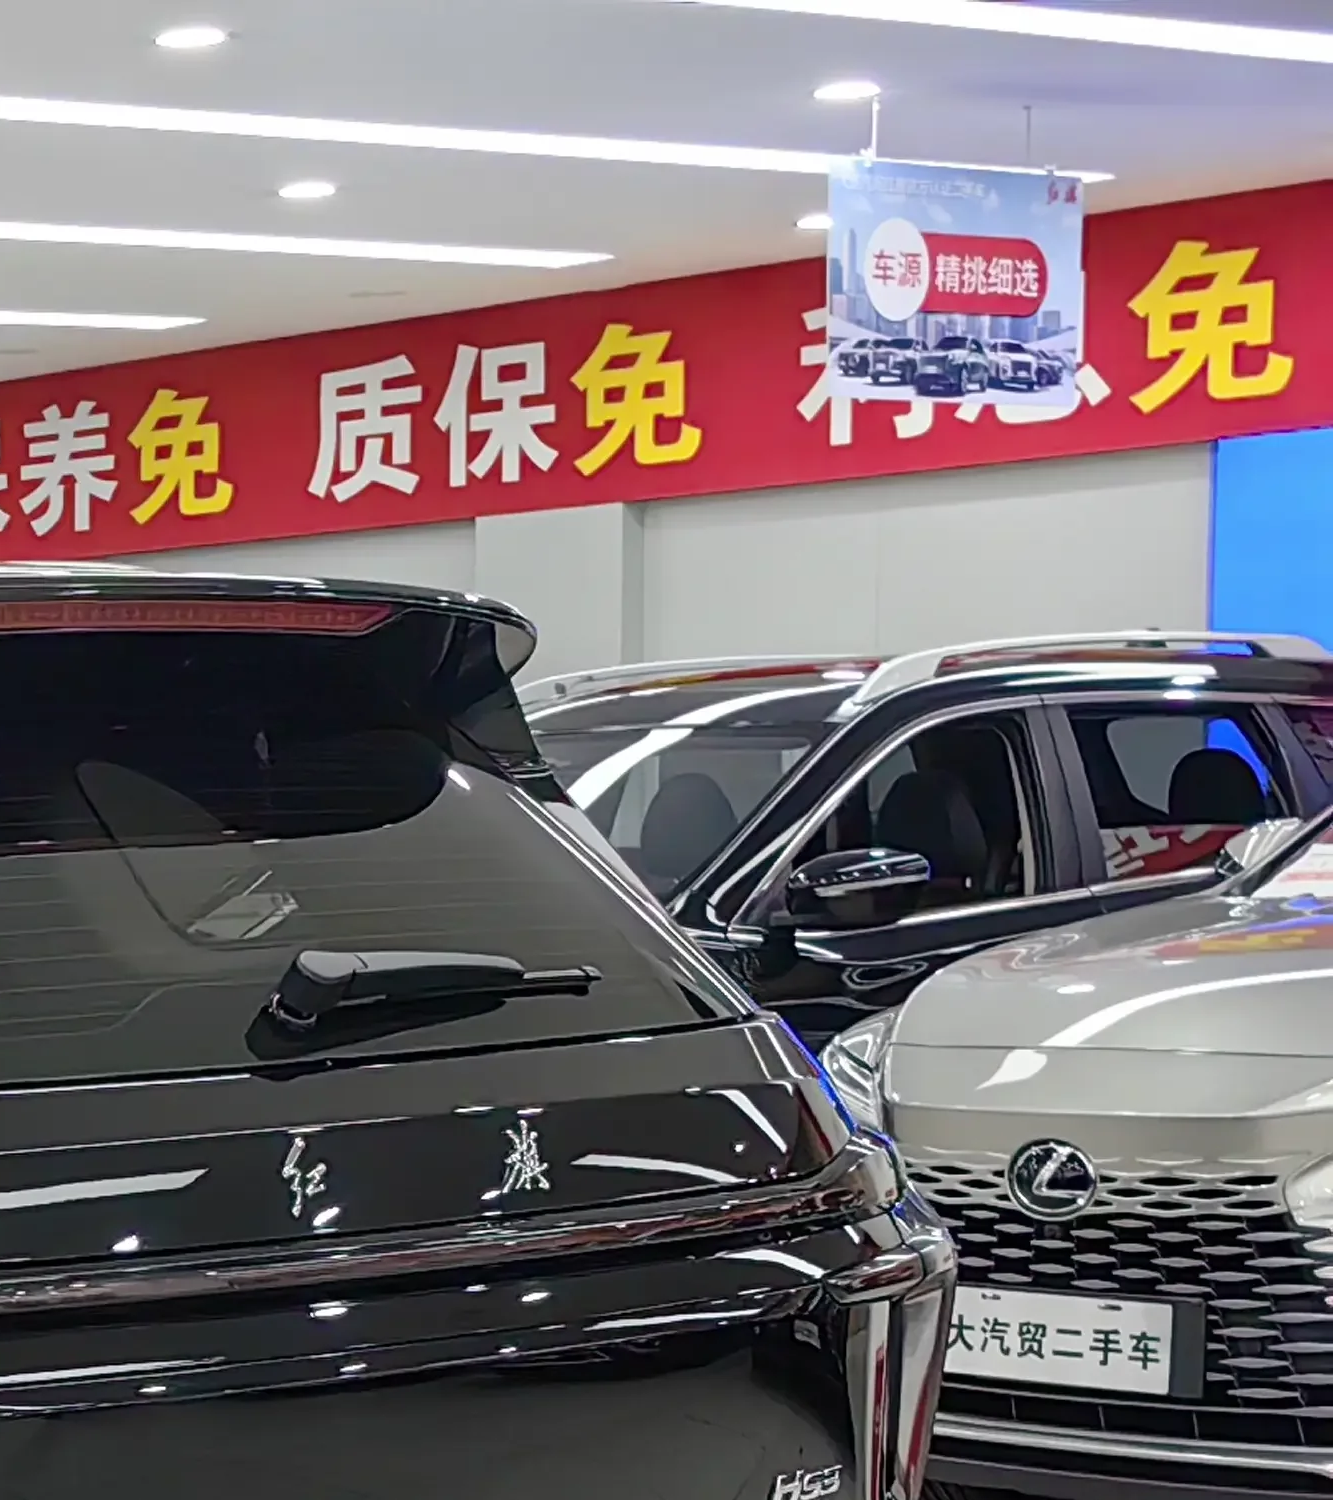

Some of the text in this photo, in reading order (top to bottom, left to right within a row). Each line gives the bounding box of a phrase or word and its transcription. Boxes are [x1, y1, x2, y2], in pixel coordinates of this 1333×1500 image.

[871, 249, 1040, 297] 车源 精挑细选
[306, 322, 704, 504] 质保免
[948, 1313, 1161, 1370] 大汽贸二手车
